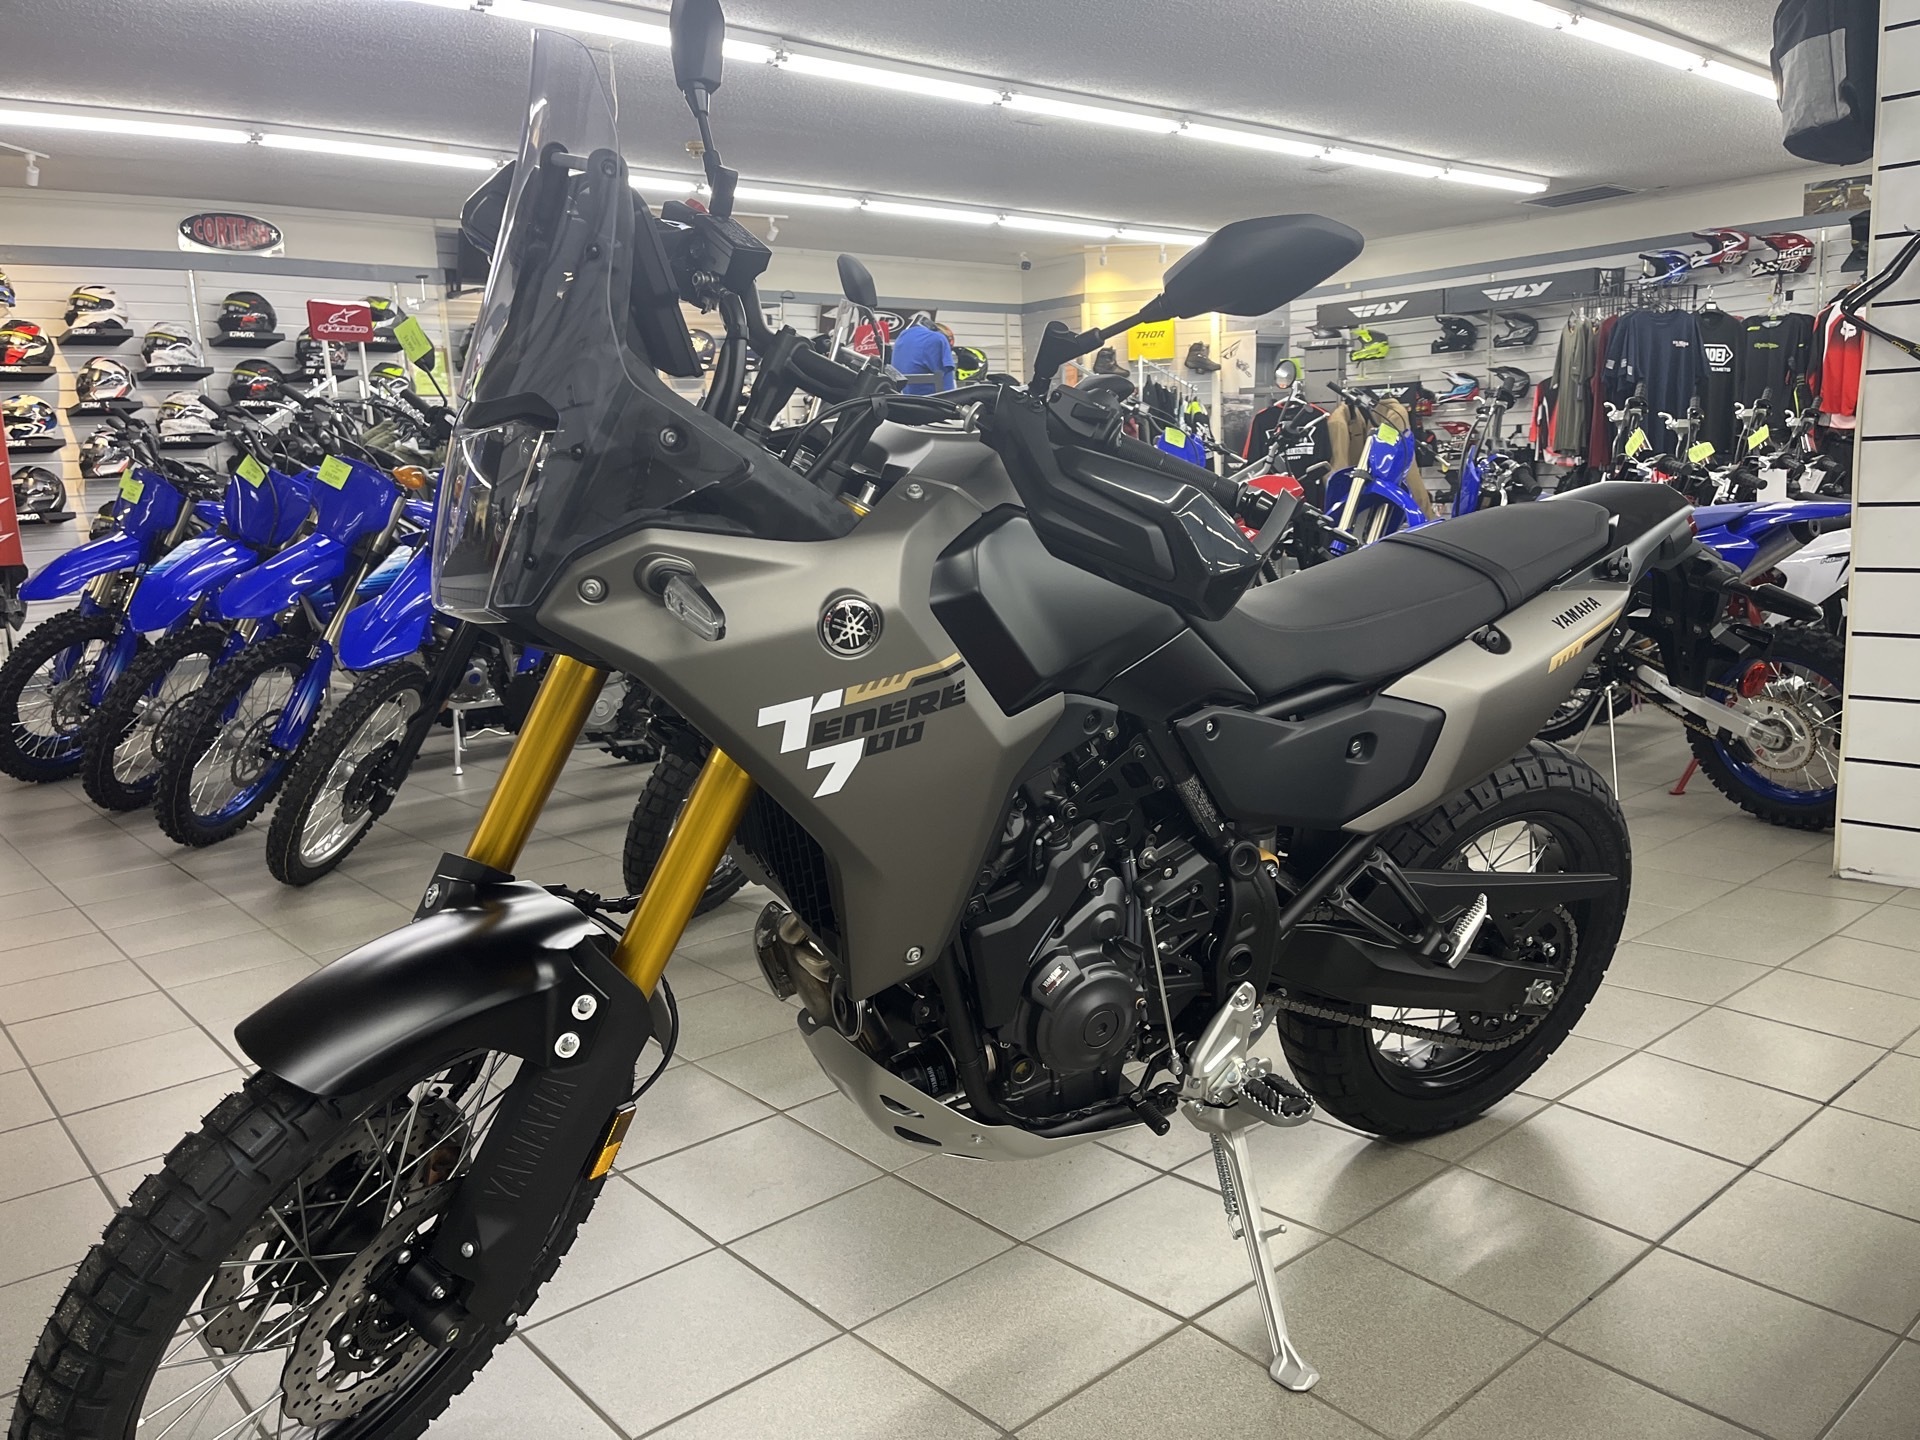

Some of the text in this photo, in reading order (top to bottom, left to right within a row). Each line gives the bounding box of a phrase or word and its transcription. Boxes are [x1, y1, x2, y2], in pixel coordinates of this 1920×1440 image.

[193, 216, 271, 250] CORTECH
[1482, 281, 1553, 302] FLY
[1348, 300, 1409, 318] FLY
[1136, 330, 1165, 339] THOR
[1551, 596, 1602, 630] YAMAHA
[806, 721, 925, 799] 700
[483, 1076, 578, 1199] YAMAHA
